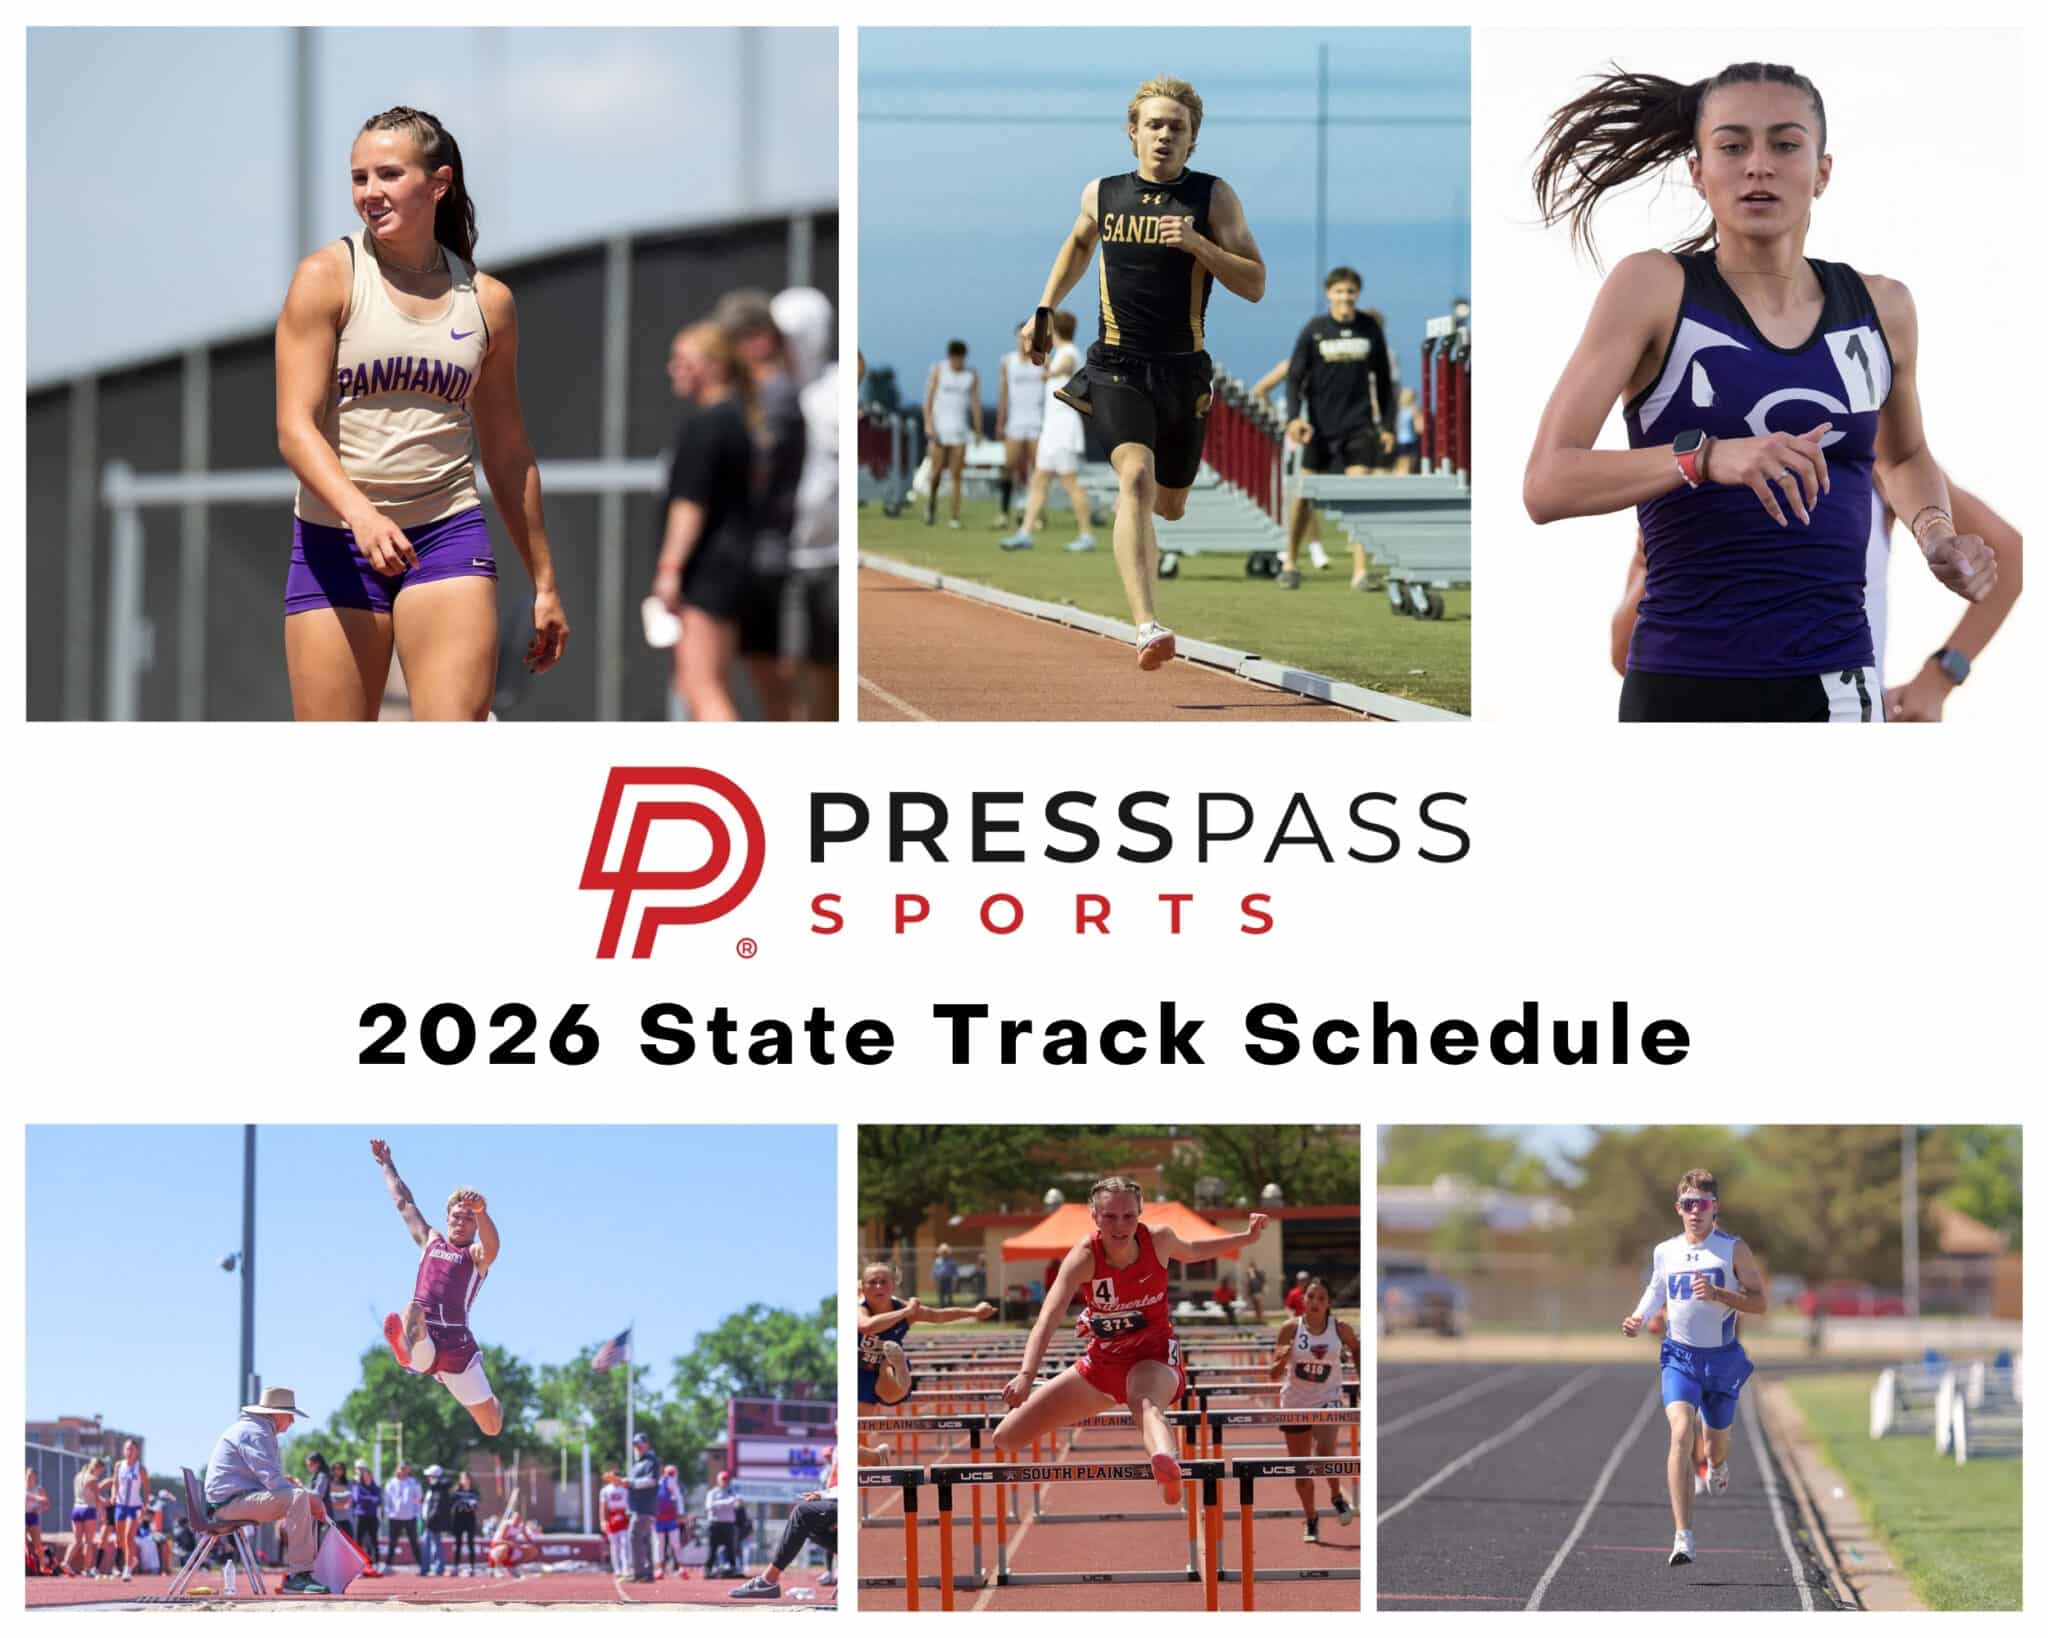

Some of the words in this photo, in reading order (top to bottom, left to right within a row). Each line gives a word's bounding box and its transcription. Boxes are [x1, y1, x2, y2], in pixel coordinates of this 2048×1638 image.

[1845, 334, 1875, 405] 1
[1096, 1281, 1112, 1302] 4
[1102, 1318, 1135, 1332] 371
[1298, 1334, 1309, 1350] 3
[1227, 1415, 1253, 1423] UCS
[1023, 1468, 1073, 1480] SOUTH
[1077, 1466, 1134, 1479] PLAINS
[1262, 1466, 1297, 1475] UCS
[859, 1475, 892, 1484] UCS
[961, 1471, 994, 1480] UCS
[1083, 1573, 1113, 1582] UCS
[1299, 1570, 1329, 1578] UCS
[866, 1578, 897, 1586] UCS
